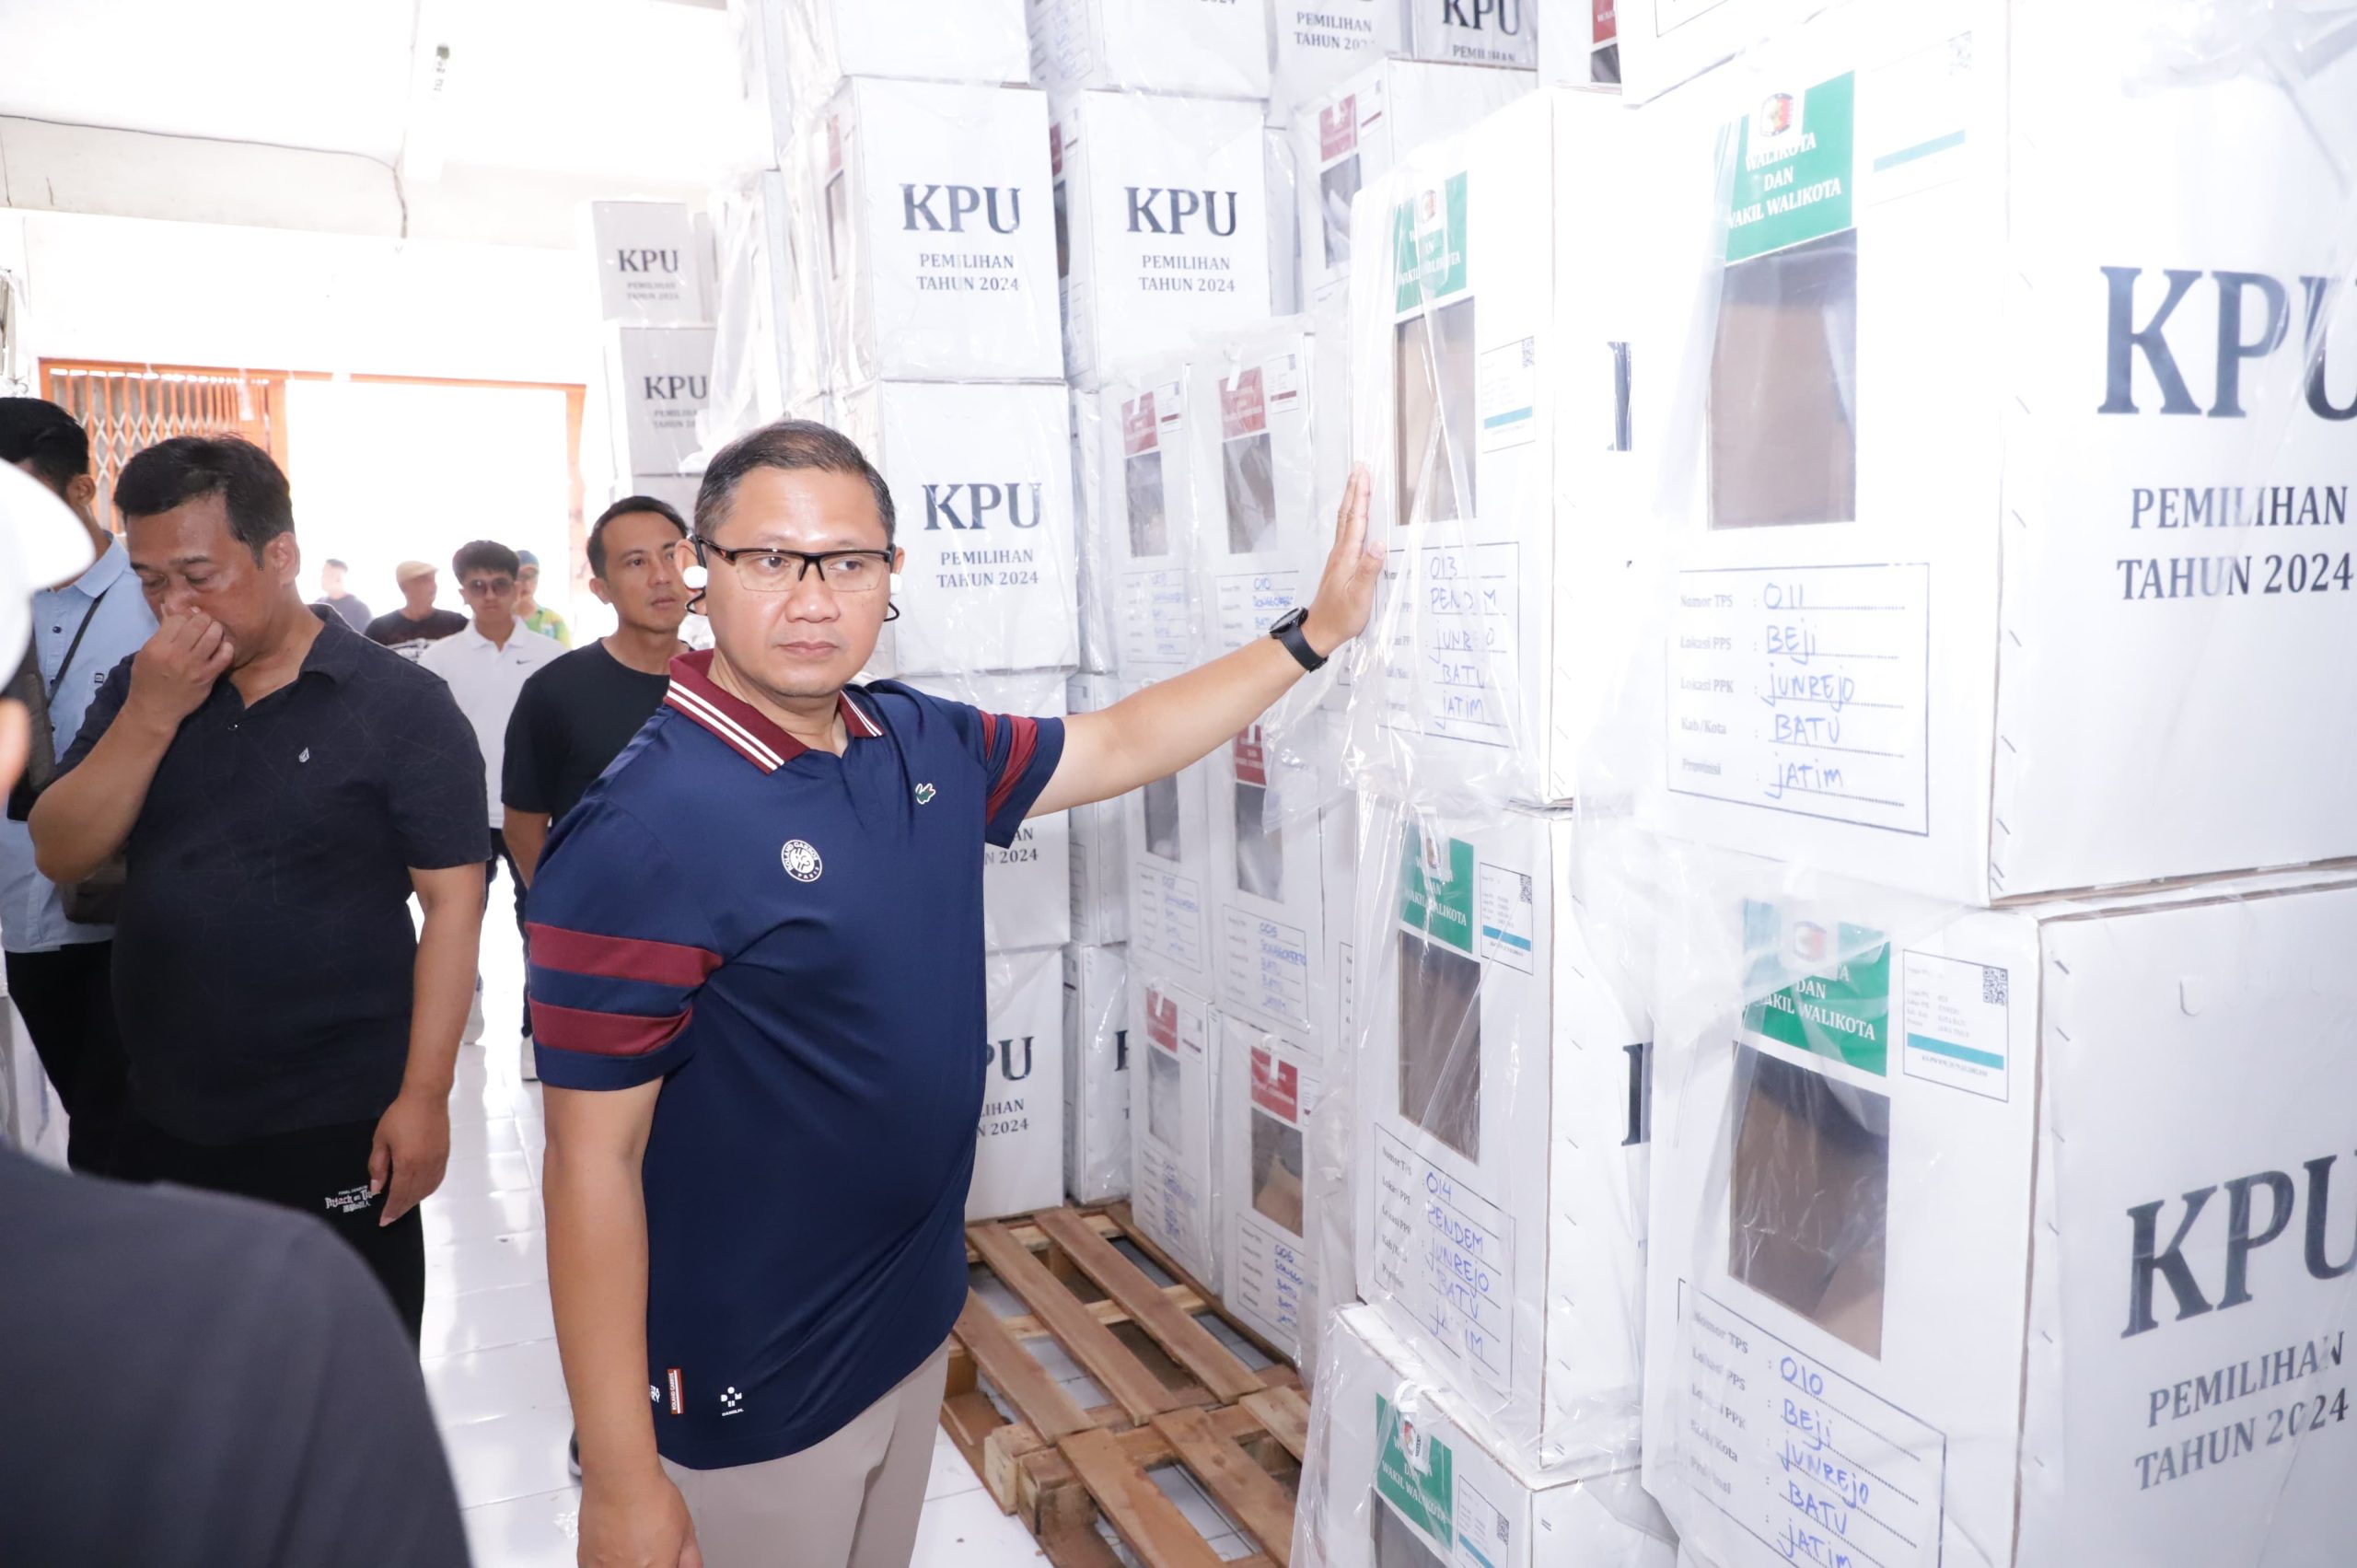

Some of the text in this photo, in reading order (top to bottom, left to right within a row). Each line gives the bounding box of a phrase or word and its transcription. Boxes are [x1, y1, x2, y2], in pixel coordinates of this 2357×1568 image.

[1296, 12, 1372, 33] PEMILIHAN
[1442, 0, 1520, 36] KPU
[1294, 32, 1341, 49] TAHUN
[1763, 166, 1794, 192] DAN
[899, 183, 1021, 235] KPU
[1766, 177, 1841, 216] WALIKOTA
[1124, 186, 1238, 237] KPU
[618, 250, 679, 273] KPU
[1142, 255, 1231, 270] PEMILIHAN
[916, 275, 1020, 292] TAHUN 2024
[1138, 276, 1237, 293] TAHUN 2024
[2096, 265, 2357, 423] KPU
[644, 375, 708, 401] KPU
[922, 482, 1042, 530] KPU
[2130, 485, 2349, 529] PEMILIHAN
[941, 549, 1034, 566] PEMILIHAN
[935, 570, 1039, 588] TAHUN 2024
[2117, 552, 2354, 600] TAHUN 2024
[1430, 587, 1497, 612] PENDM
[1713, 594, 1734, 608] TPS
[1712, 636, 1733, 651] PPS
[1713, 679, 1735, 694] PPK
[1774, 713, 1840, 745] BATU
[999, 847, 1039, 865] 2024
[1796, 979, 1827, 1000] DAN
[1799, 1002, 1875, 1040] WALIKOTA
[990, 1118, 1030, 1136] 2024
[2120, 1148, 2357, 1340] KPU
[1728, 1331, 1749, 1354] TPS
[2146, 1330, 2345, 1428] PEMILIHAN
[1724, 1408, 1747, 1431] PPK
[2134, 1387, 2350, 1492] TAHUN 2024
[1381, 1459, 1406, 1491] WAKIL
[1788, 1479, 1848, 1536] BATU
